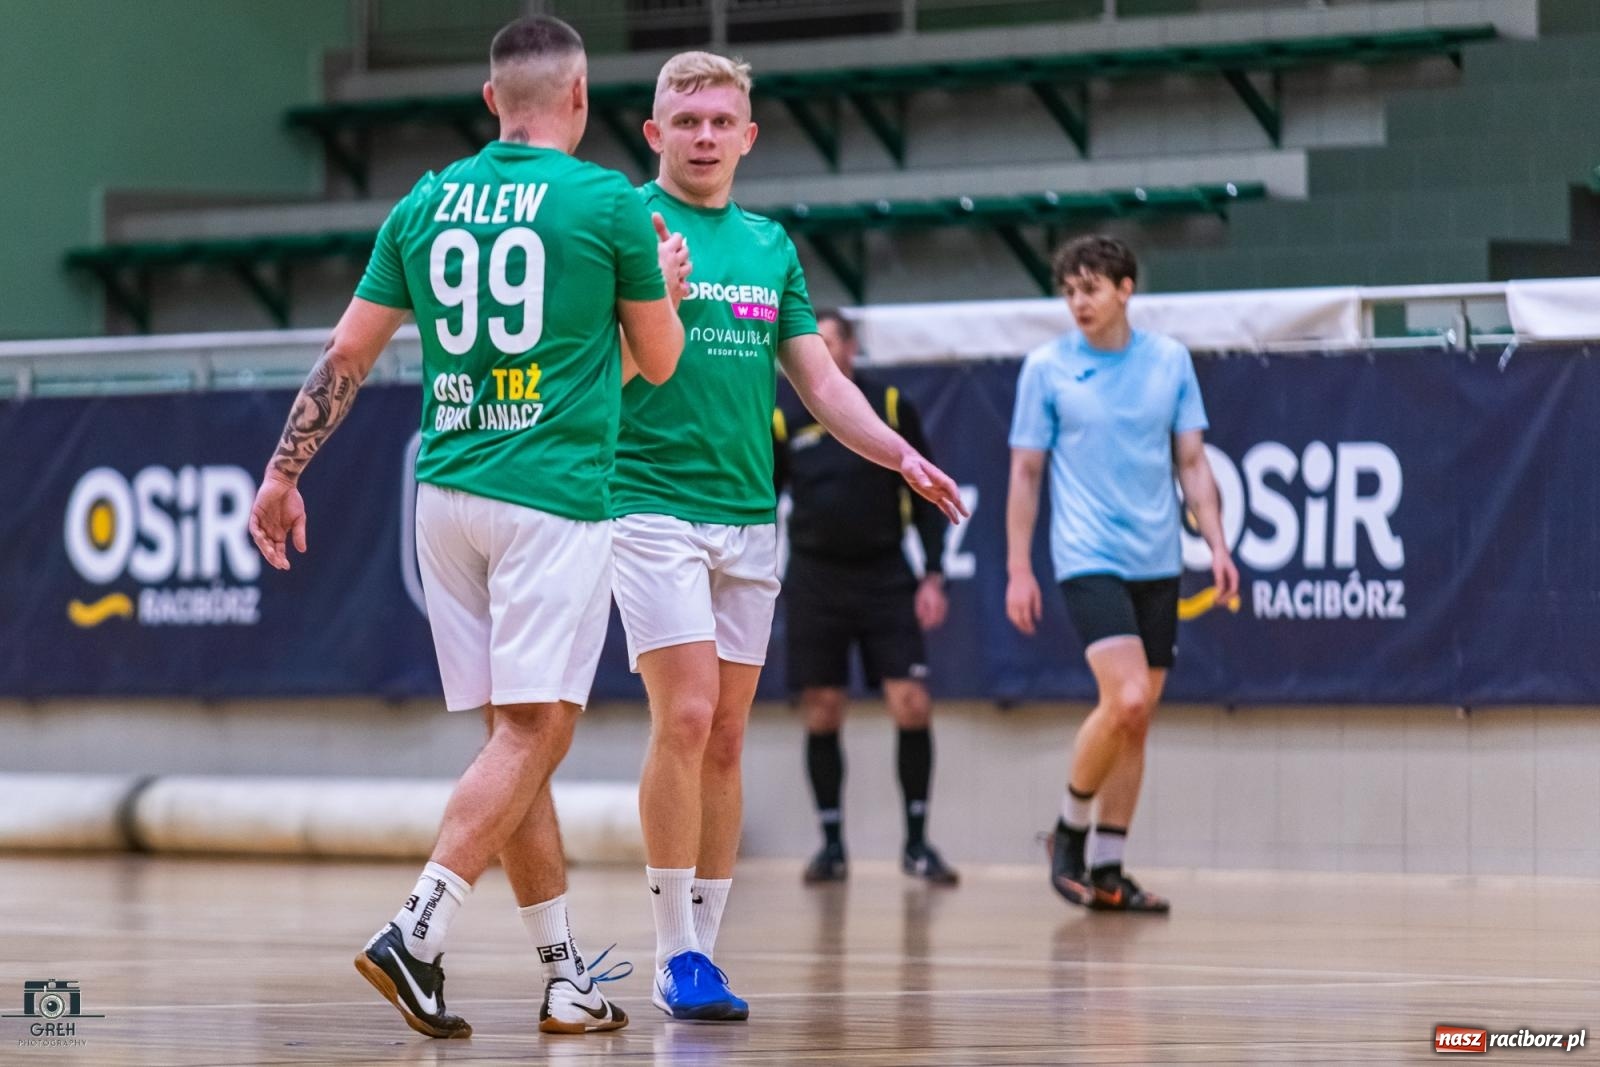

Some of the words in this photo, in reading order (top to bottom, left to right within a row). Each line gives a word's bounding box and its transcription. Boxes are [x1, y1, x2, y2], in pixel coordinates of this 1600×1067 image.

[433, 183, 549, 224] ZALEW
[429, 226, 546, 355] 99
[737, 306, 749, 316] W
[707, 348, 737, 356] RESORT
[433, 373, 474, 404] OSG
[491, 363, 542, 401] TBŻ
[478, 403, 544, 430] JANACZ
[64, 465, 261, 585] OSiR
[1252, 569, 1406, 619] RACIBÓRZ
[540, 944, 567, 963] FS
